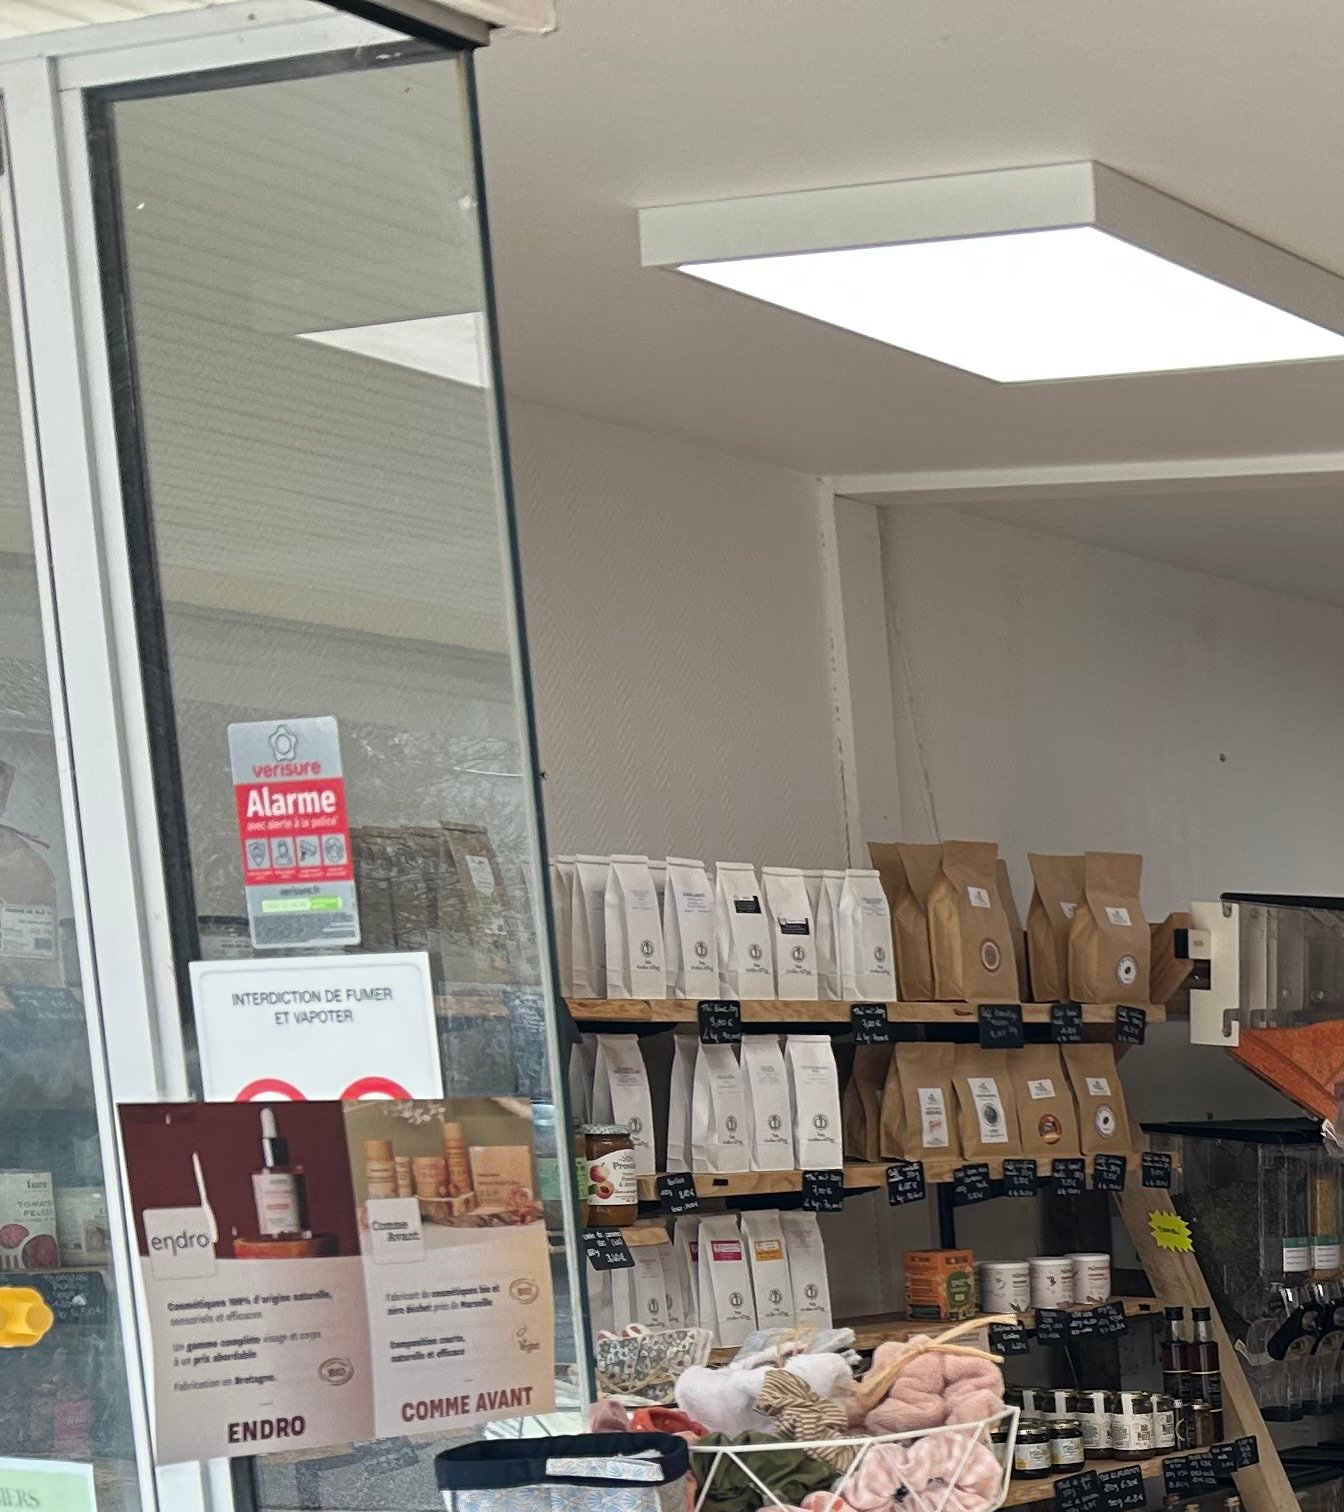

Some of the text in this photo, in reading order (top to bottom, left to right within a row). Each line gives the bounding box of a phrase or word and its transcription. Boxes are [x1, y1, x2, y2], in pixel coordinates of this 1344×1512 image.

[253, 760, 321, 778] verisure
[246, 786, 336, 817] Alarme
[232, 987, 393, 1006] INTERDICTION DE FUMER
[274, 1009, 354, 1024] ET VAPOTER
[151, 1229, 210, 1259] endro
[401, 1386, 534, 1423] COMME AVANT
[227, 1415, 307, 1444] ENDRO
